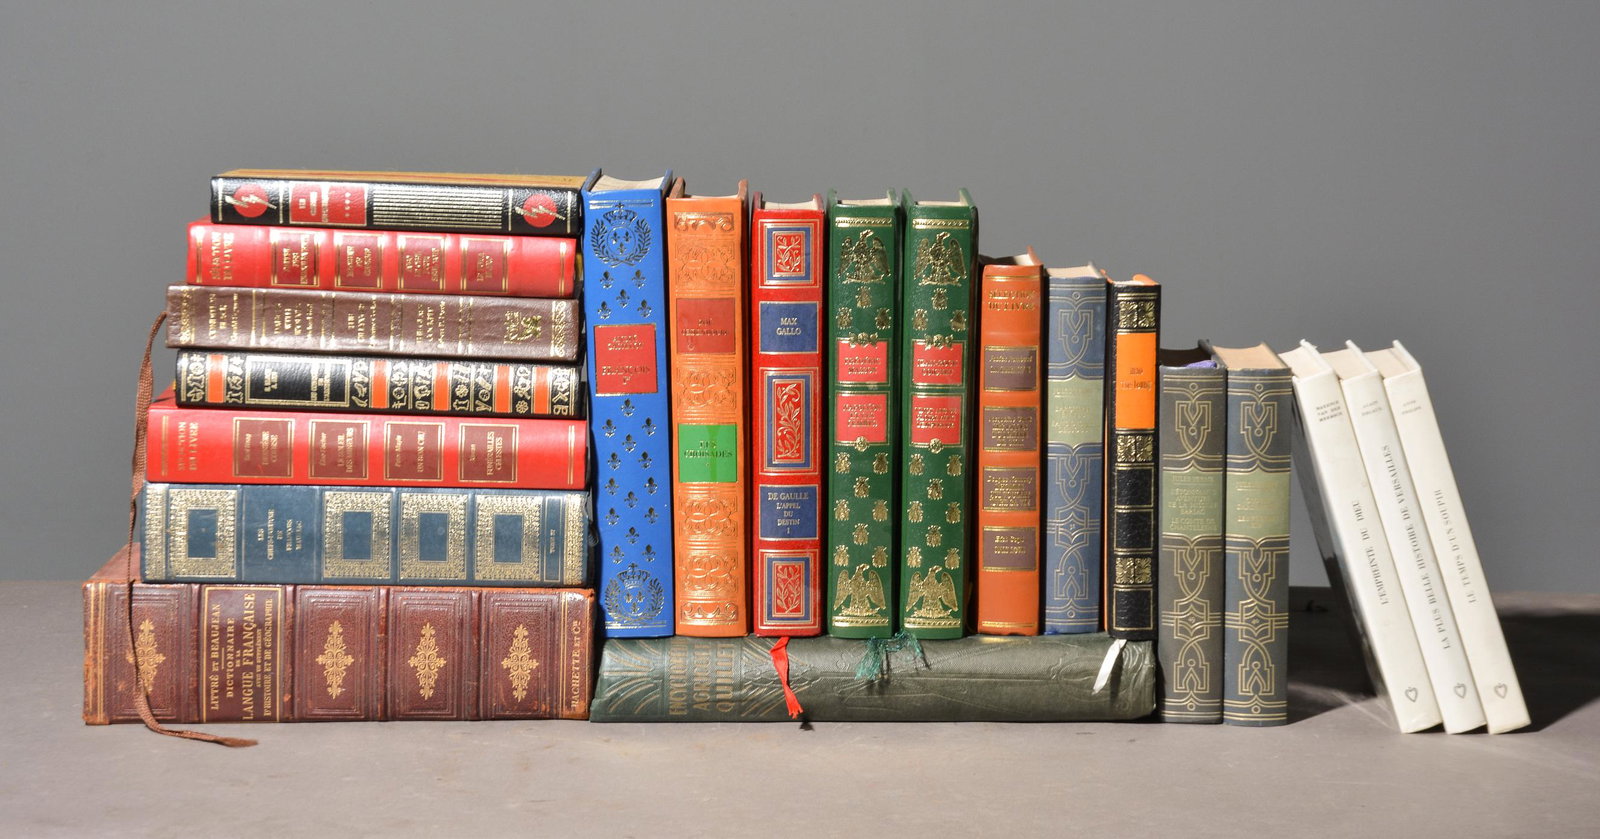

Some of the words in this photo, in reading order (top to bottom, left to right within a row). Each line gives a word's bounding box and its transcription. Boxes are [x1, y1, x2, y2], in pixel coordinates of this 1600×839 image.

[776, 327, 802, 336] GALLO
[780, 317, 798, 326] MAX
[1382, 444, 1405, 505] VERSAILLES
[767, 492, 779, 501] DE
[780, 492, 809, 501] GAULLE
[776, 502, 801, 510] L'APPEL
[1434, 489, 1450, 525] SOUPIR
[777, 518, 801, 527] DESTIN
[784, 510, 794, 518] DU
[1352, 501, 1365, 522] DIEU
[1400, 507, 1410, 522] DE
[1360, 528, 1370, 541] DU
[1445, 527, 1460, 552] D'UN
[1405, 525, 1426, 570] HISTOIRE
[1365, 546, 1389, 606] L'EMPREINTE
[1455, 557, 1471, 587] TEMPS
[1421, 574, 1437, 606] BELLE
[1467, 591, 1477, 604] LE
[210, 603, 221, 659] BEAUJEAN
[242, 592, 257, 666] FRANÇAISE
[263, 598, 273, 648] GÉOGRAPHIE
[1432, 608, 1445, 634] PLUS
[573, 636, 581, 647] ET
[1440, 637, 1451, 650] LA
[212, 660, 220, 672] ET
[226, 617, 235, 698] DICTIONNAIRE
[264, 650, 272, 662] DE
[264, 662, 272, 672] ET
[571, 650, 580, 708] HACHETTE
[716, 642, 736, 713] QUILLET
[208, 674, 220, 711] LITTRÉ
[242, 671, 254, 721] LANGUE
